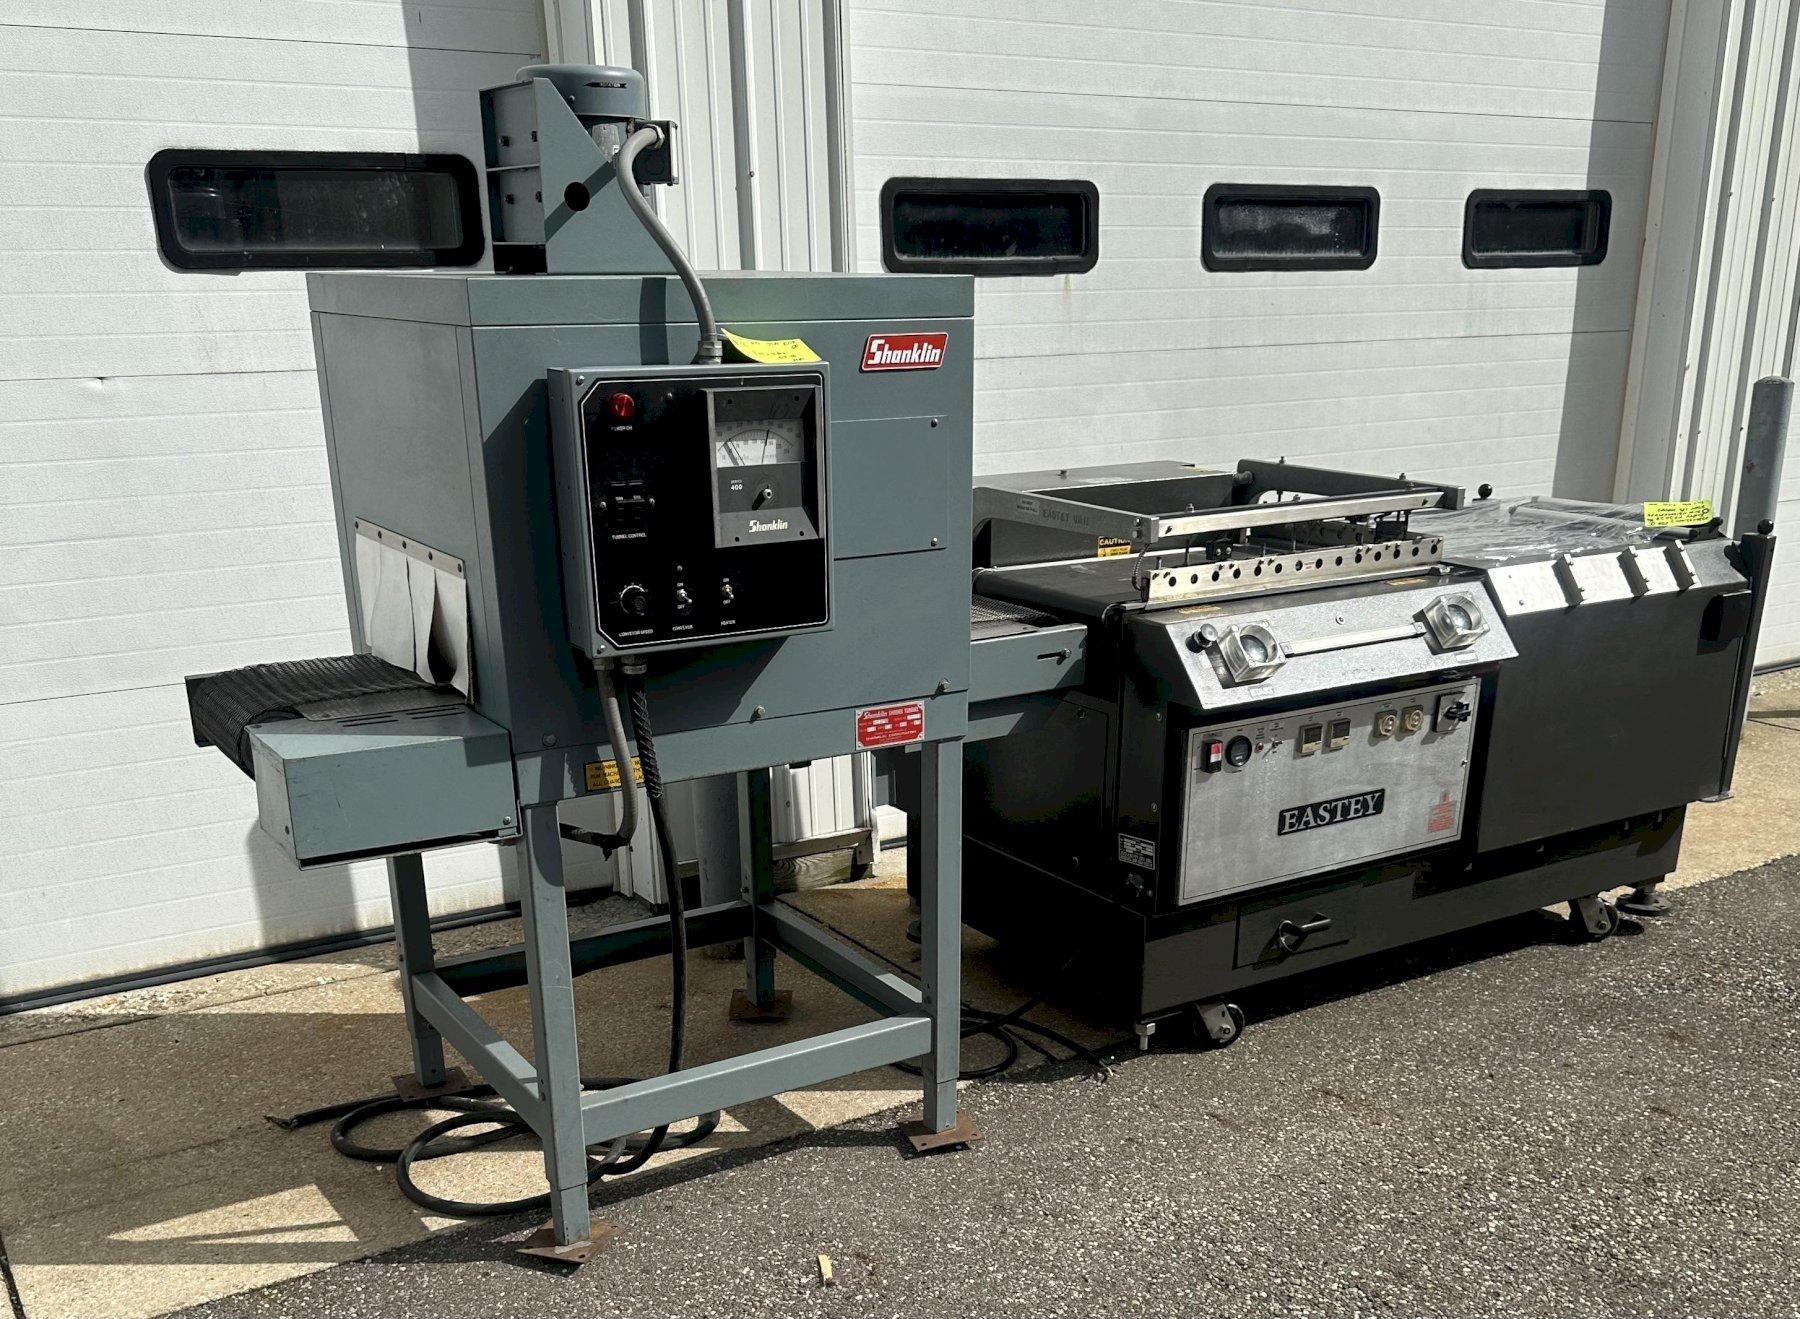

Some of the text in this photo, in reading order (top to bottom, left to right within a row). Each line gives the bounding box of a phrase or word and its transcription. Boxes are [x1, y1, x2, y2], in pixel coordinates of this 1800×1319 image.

[867, 339, 941, 364] Shanklin
[748, 519, 788, 533] Shanklin
[1281, 792, 1382, 834] EASTEY
